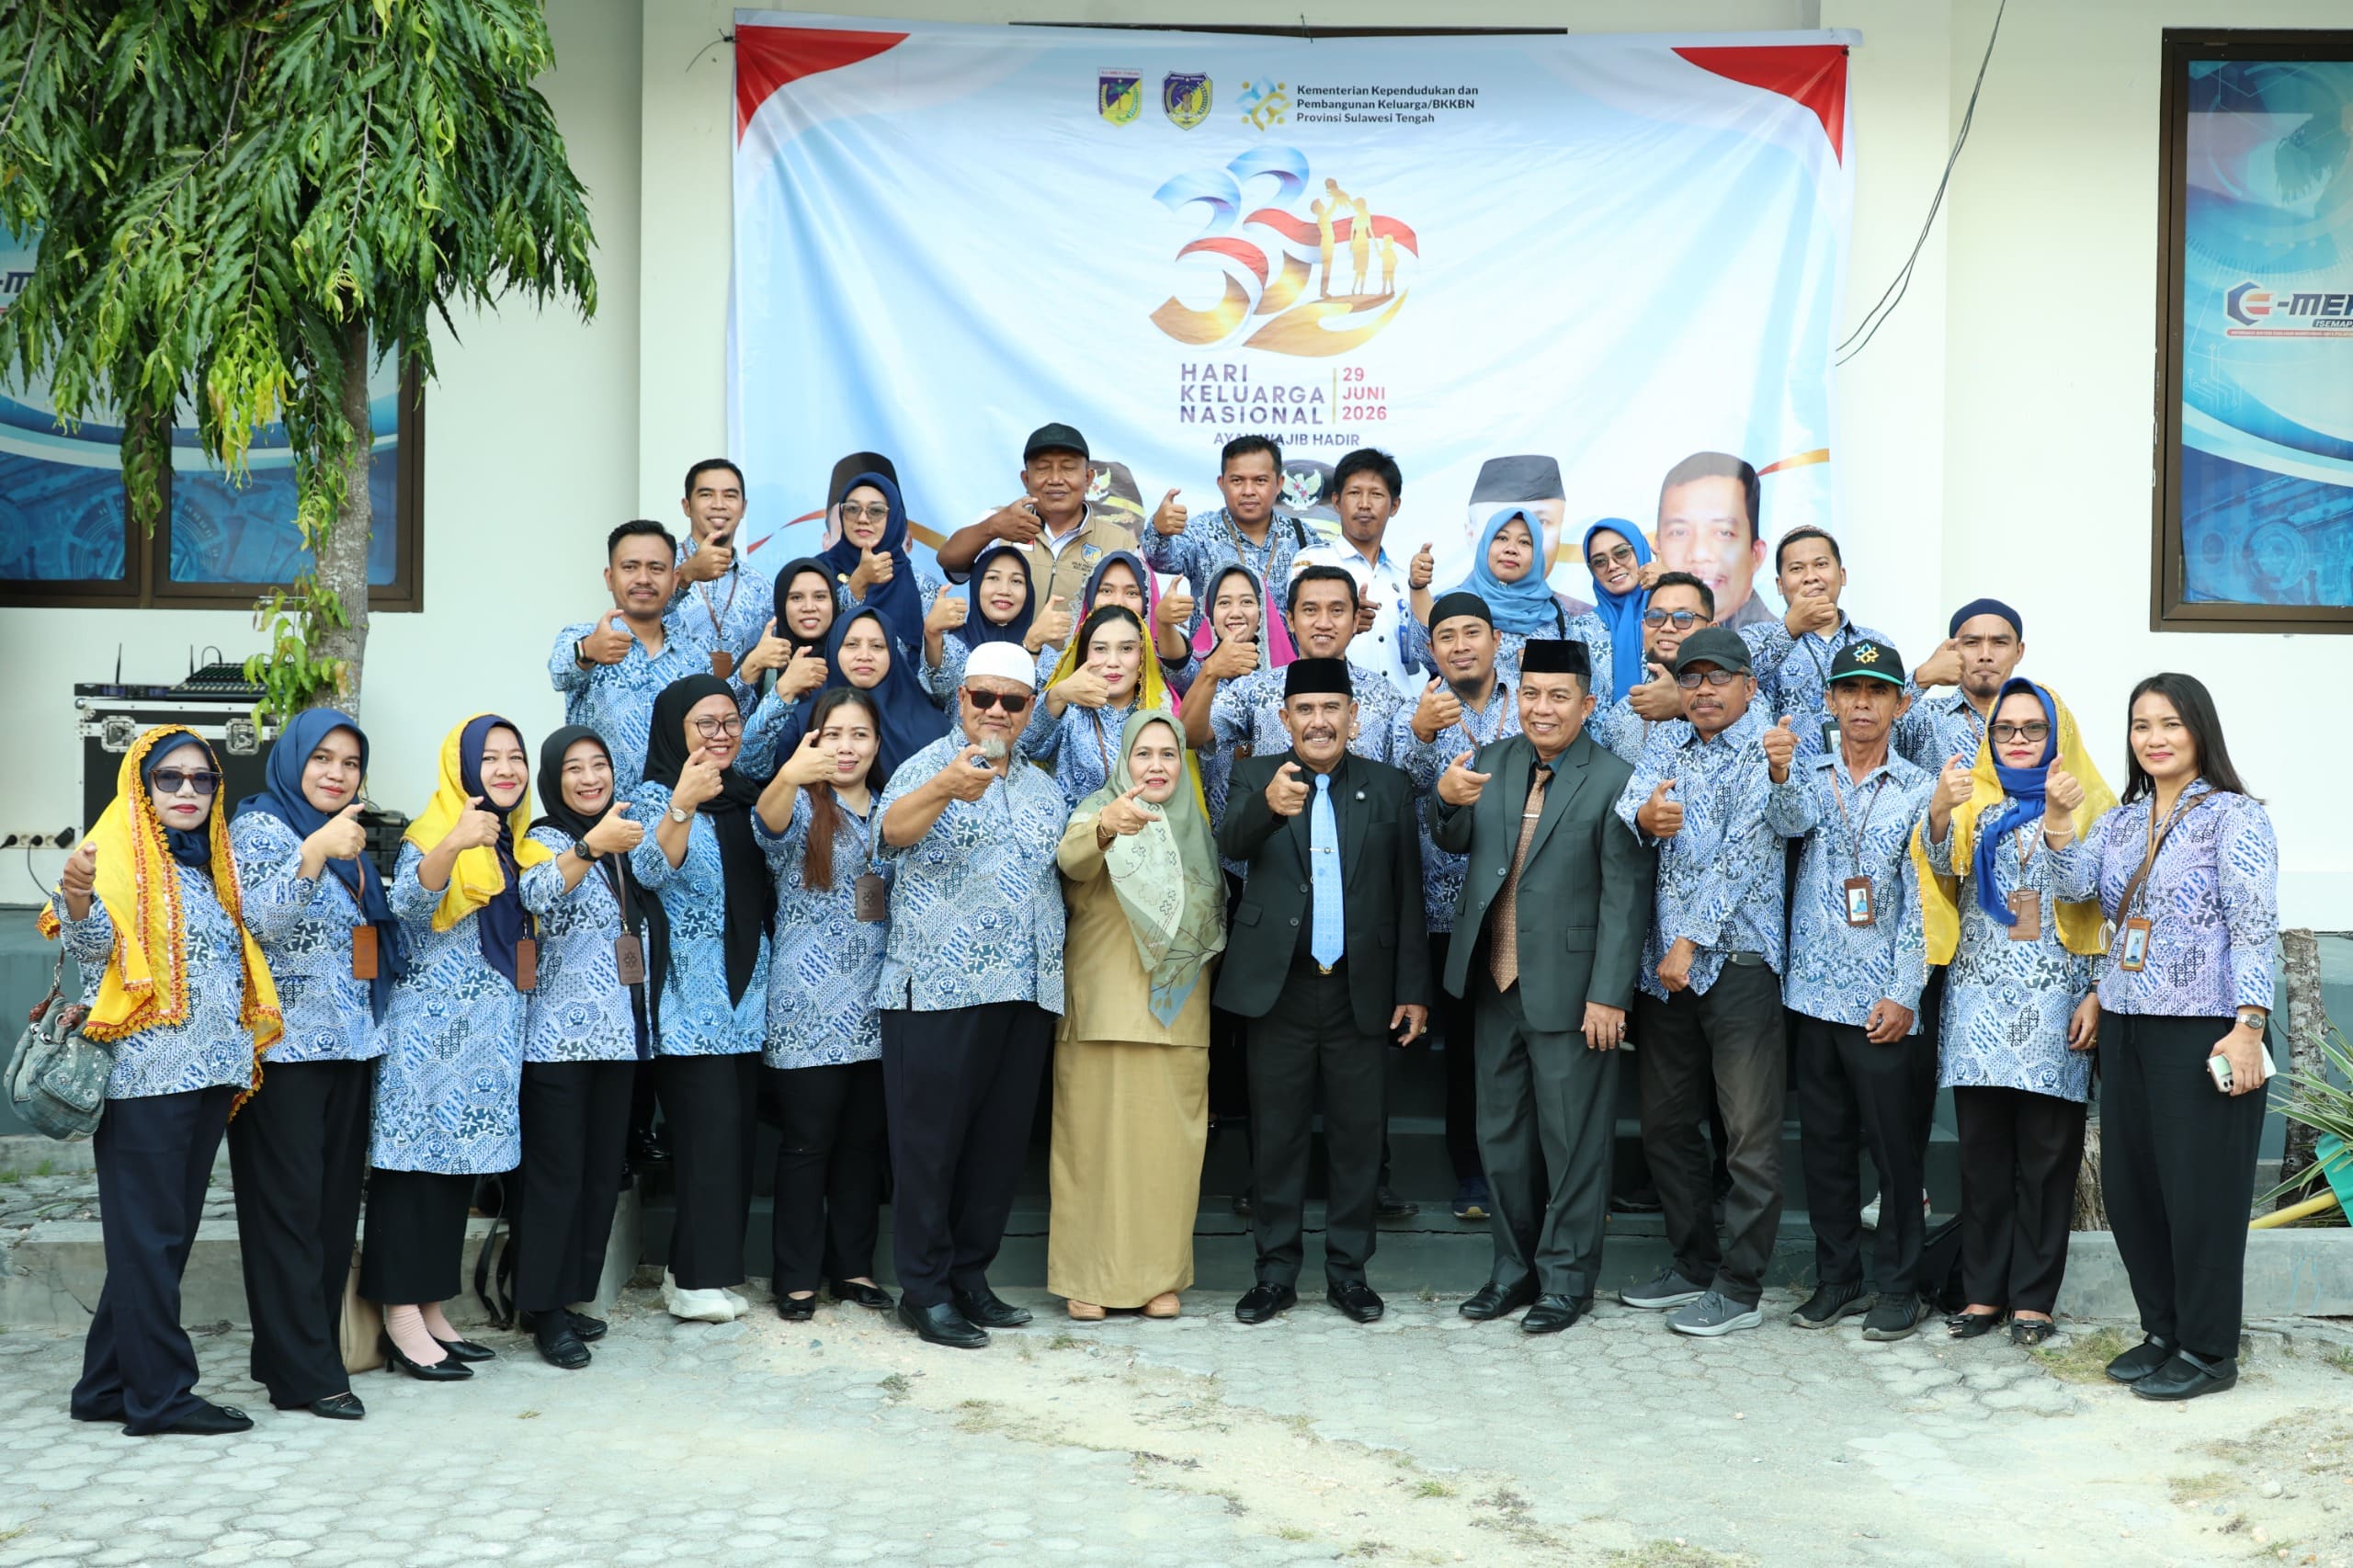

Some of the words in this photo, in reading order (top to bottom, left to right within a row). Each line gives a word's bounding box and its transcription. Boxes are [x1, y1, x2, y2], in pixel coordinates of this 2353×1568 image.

[1297, 85, 1369, 96] Kementerian
[1371, 85, 1455, 97] Kependudukan
[1458, 85, 1479, 96] dan
[1297, 98, 1375, 110] Pembangunan
[1378, 98, 1475, 111] Keluarga/BKKBN
[1297, 112, 1342, 122] Provinsi
[1344, 112, 1392, 123] Sulawesi
[1395, 113, 1435, 125] Tengah
[2315, 319, 2353, 327] ISEMAP
[1180, 363, 1248, 382] HARI
[1342, 367, 1365, 381] 29
[1180, 384, 1325, 403] KELUARGA
[1342, 386, 1385, 401] JUNI
[1180, 405, 1324, 425] NASIONAL
[1341, 405, 1387, 421] 2026
[1213, 432, 1255, 445] AY
[1313, 434, 1360, 446] HADIR
